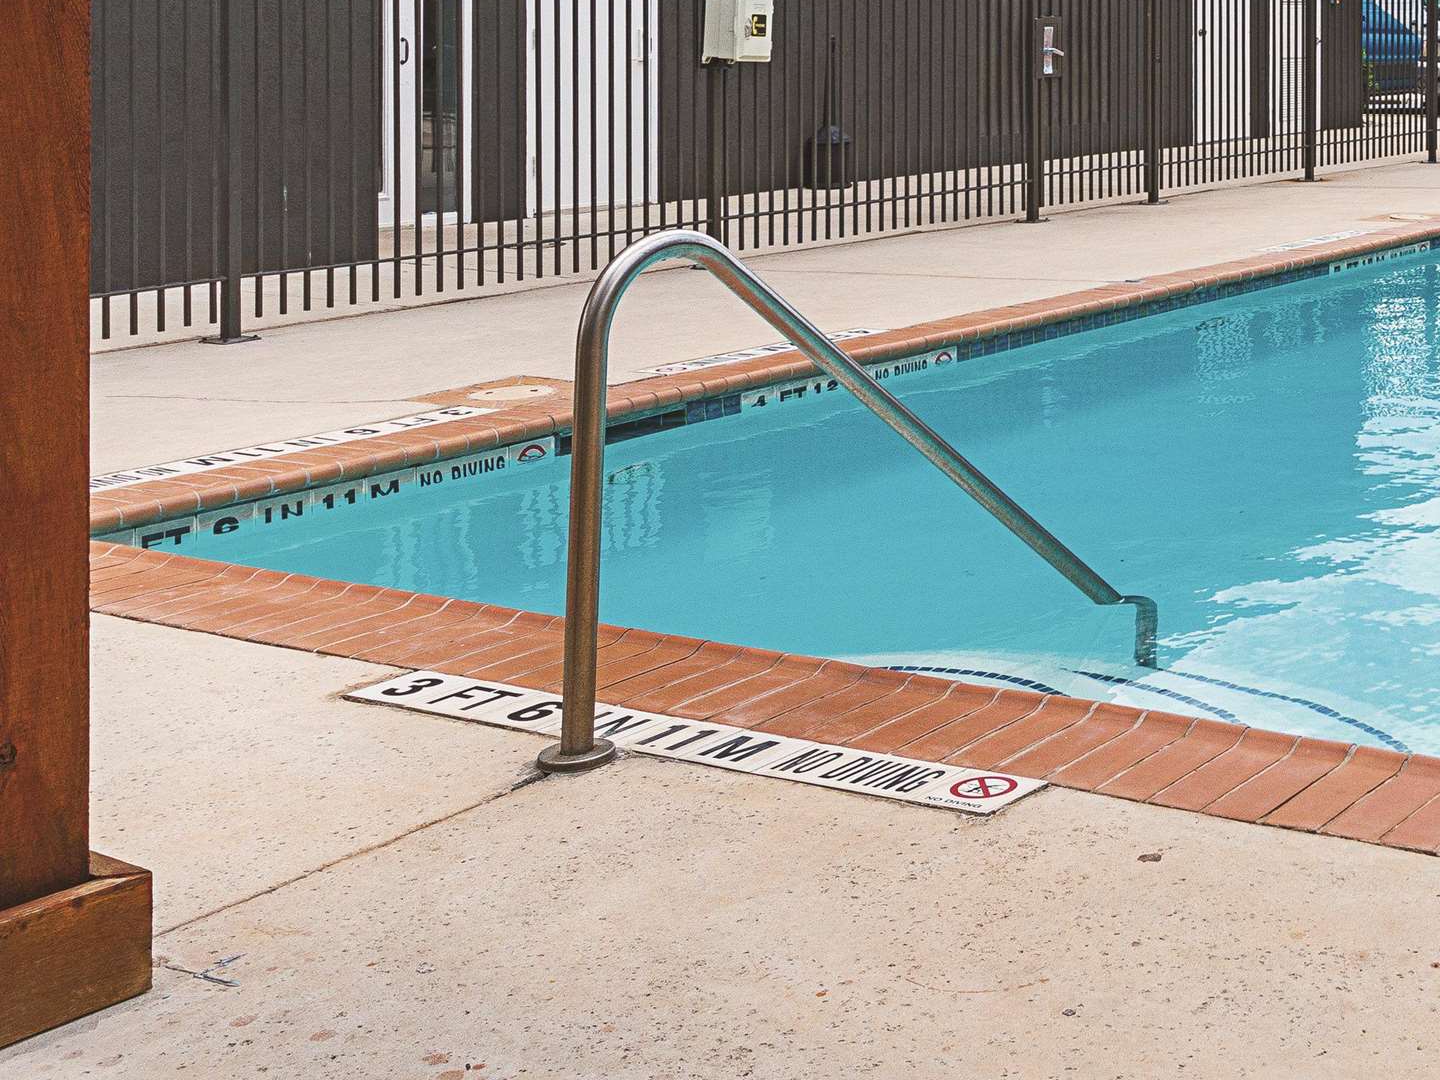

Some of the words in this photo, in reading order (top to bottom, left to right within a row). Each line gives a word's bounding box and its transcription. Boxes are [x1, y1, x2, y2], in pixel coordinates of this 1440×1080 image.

[265, 501, 303, 524] IN
[371, 480, 399, 498] M
[420, 470, 443, 487] NO
[451, 455, 505, 480] DIVING
[381, 677, 444, 696] 3
[427, 685, 523, 710] FT
[507, 701, 563, 721] 6
[697, 735, 781, 762] M
[770, 748, 844, 774] NO
[818, 756, 946, 793] DIVING
